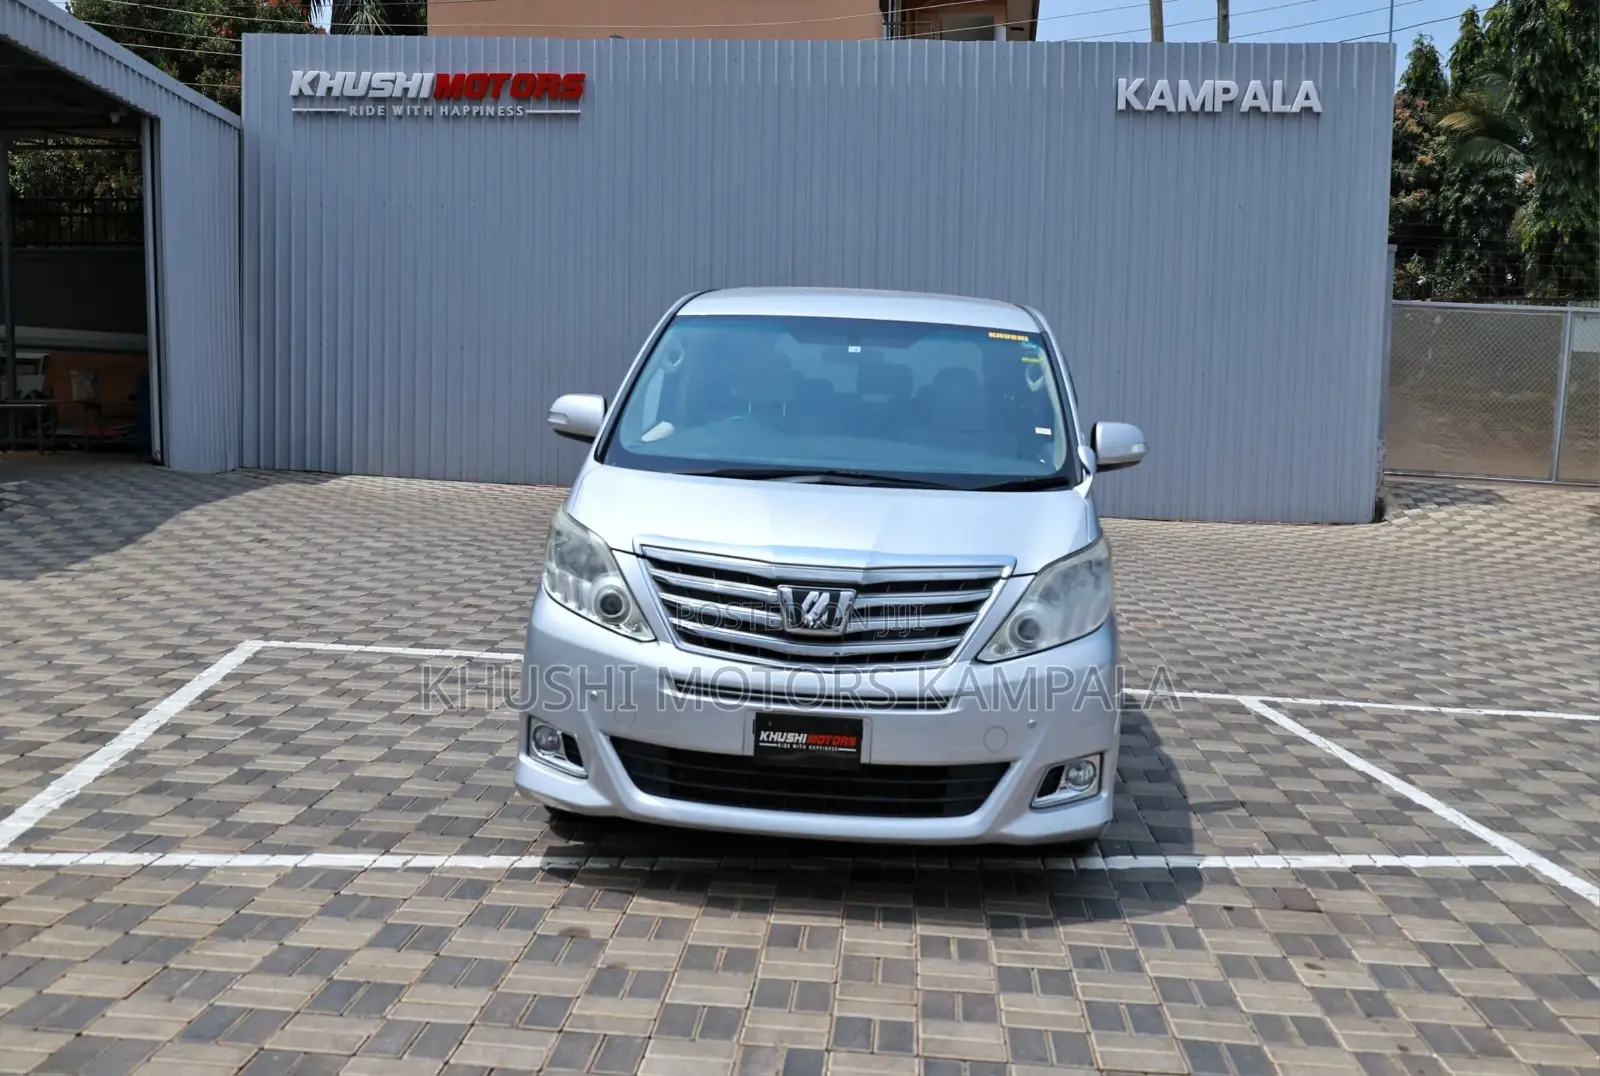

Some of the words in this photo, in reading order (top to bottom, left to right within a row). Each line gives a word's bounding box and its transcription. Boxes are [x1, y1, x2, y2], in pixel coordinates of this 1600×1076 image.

[1116, 77, 1323, 113] KAMPALA
[349, 105, 386, 117] RIDE
[392, 105, 434, 117] WITH
[440, 105, 525, 117] HAPPINESS
